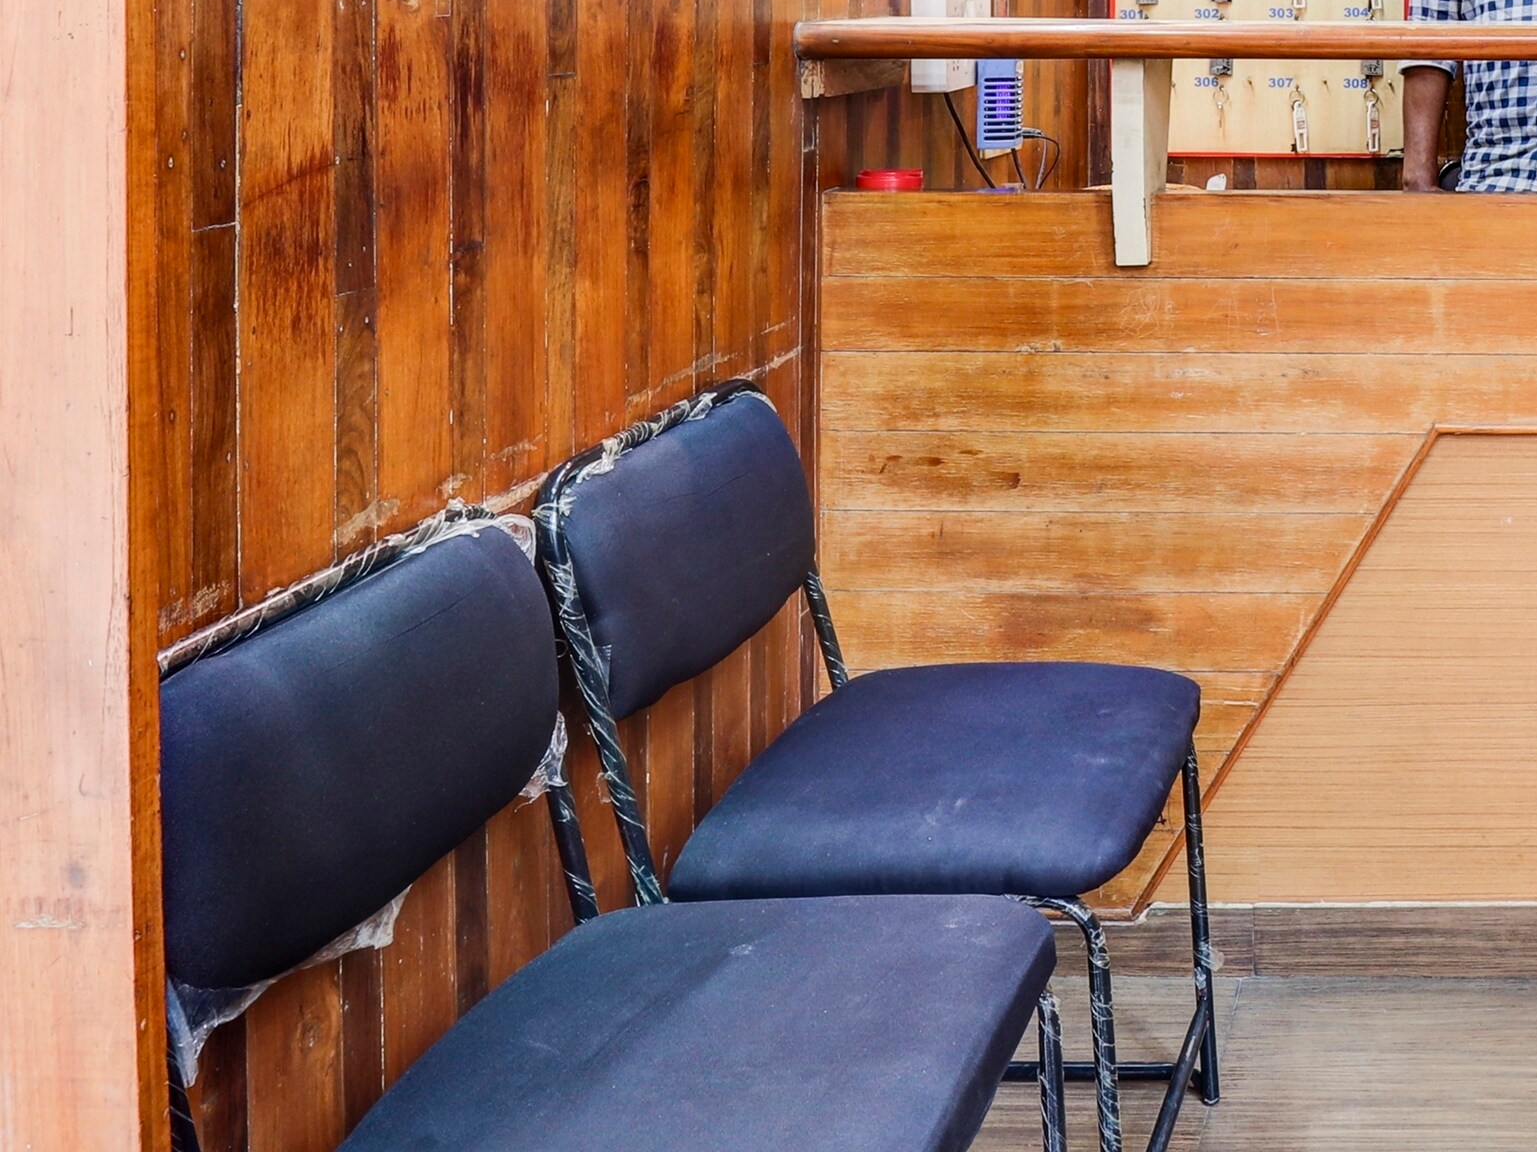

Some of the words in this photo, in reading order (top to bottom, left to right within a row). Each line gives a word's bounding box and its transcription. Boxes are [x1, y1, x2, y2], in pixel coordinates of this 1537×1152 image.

[1120, 9, 1145, 20] 301
[1194, 8, 1219, 19] 302
[1269, 7, 1294, 19] 303
[1344, 7, 1369, 18] 304
[1194, 77, 1219, 88] 306
[1268, 77, 1293, 88] 307
[1343, 78, 1368, 89] 308
